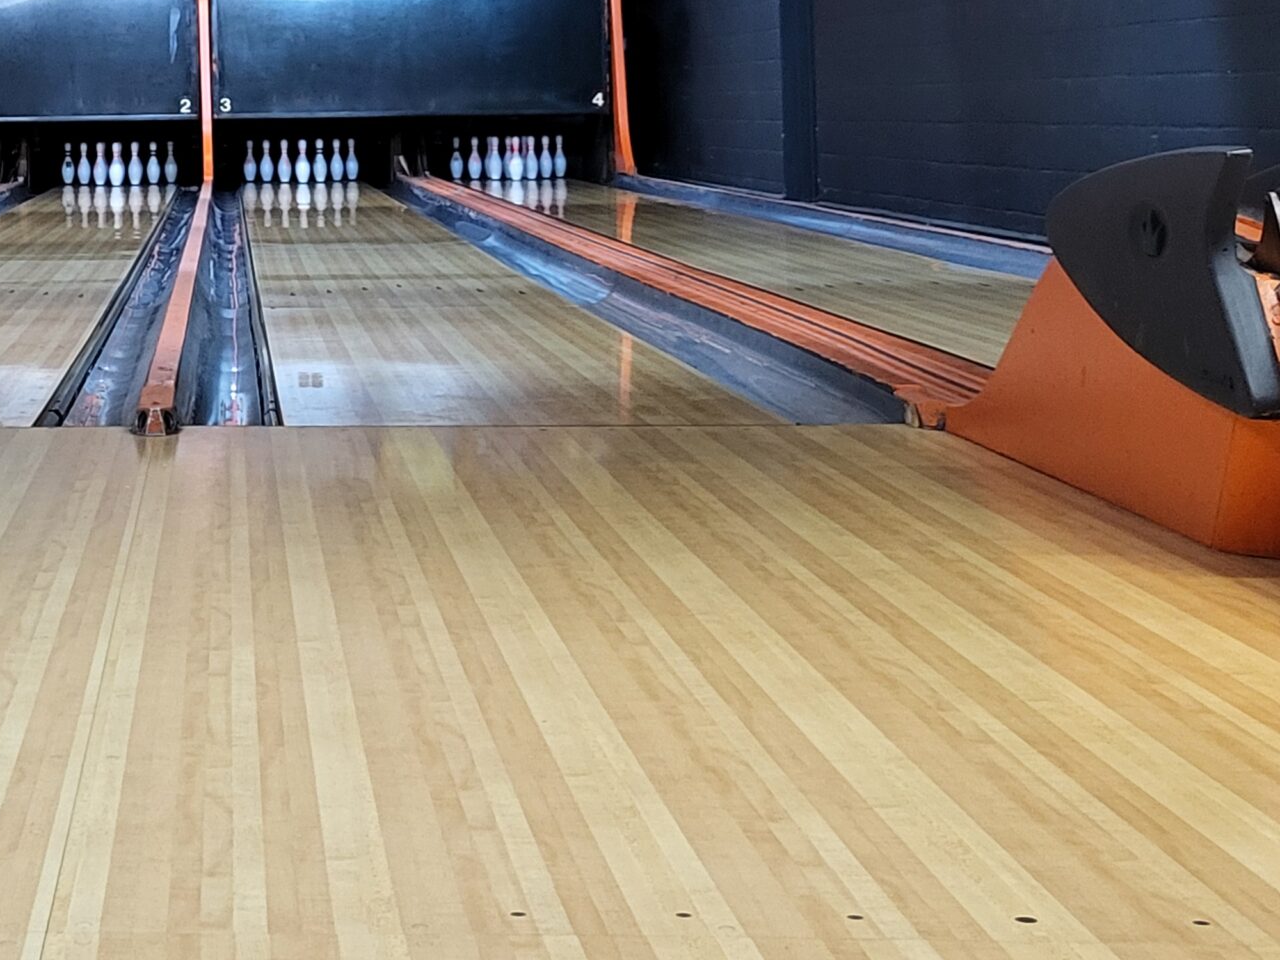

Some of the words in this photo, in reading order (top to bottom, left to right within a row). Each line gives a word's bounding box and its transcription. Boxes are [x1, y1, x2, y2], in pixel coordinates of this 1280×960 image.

[180, 98, 192, 113] 2
[220, 97, 231, 112] 3
[591, 92, 605, 107] 4
